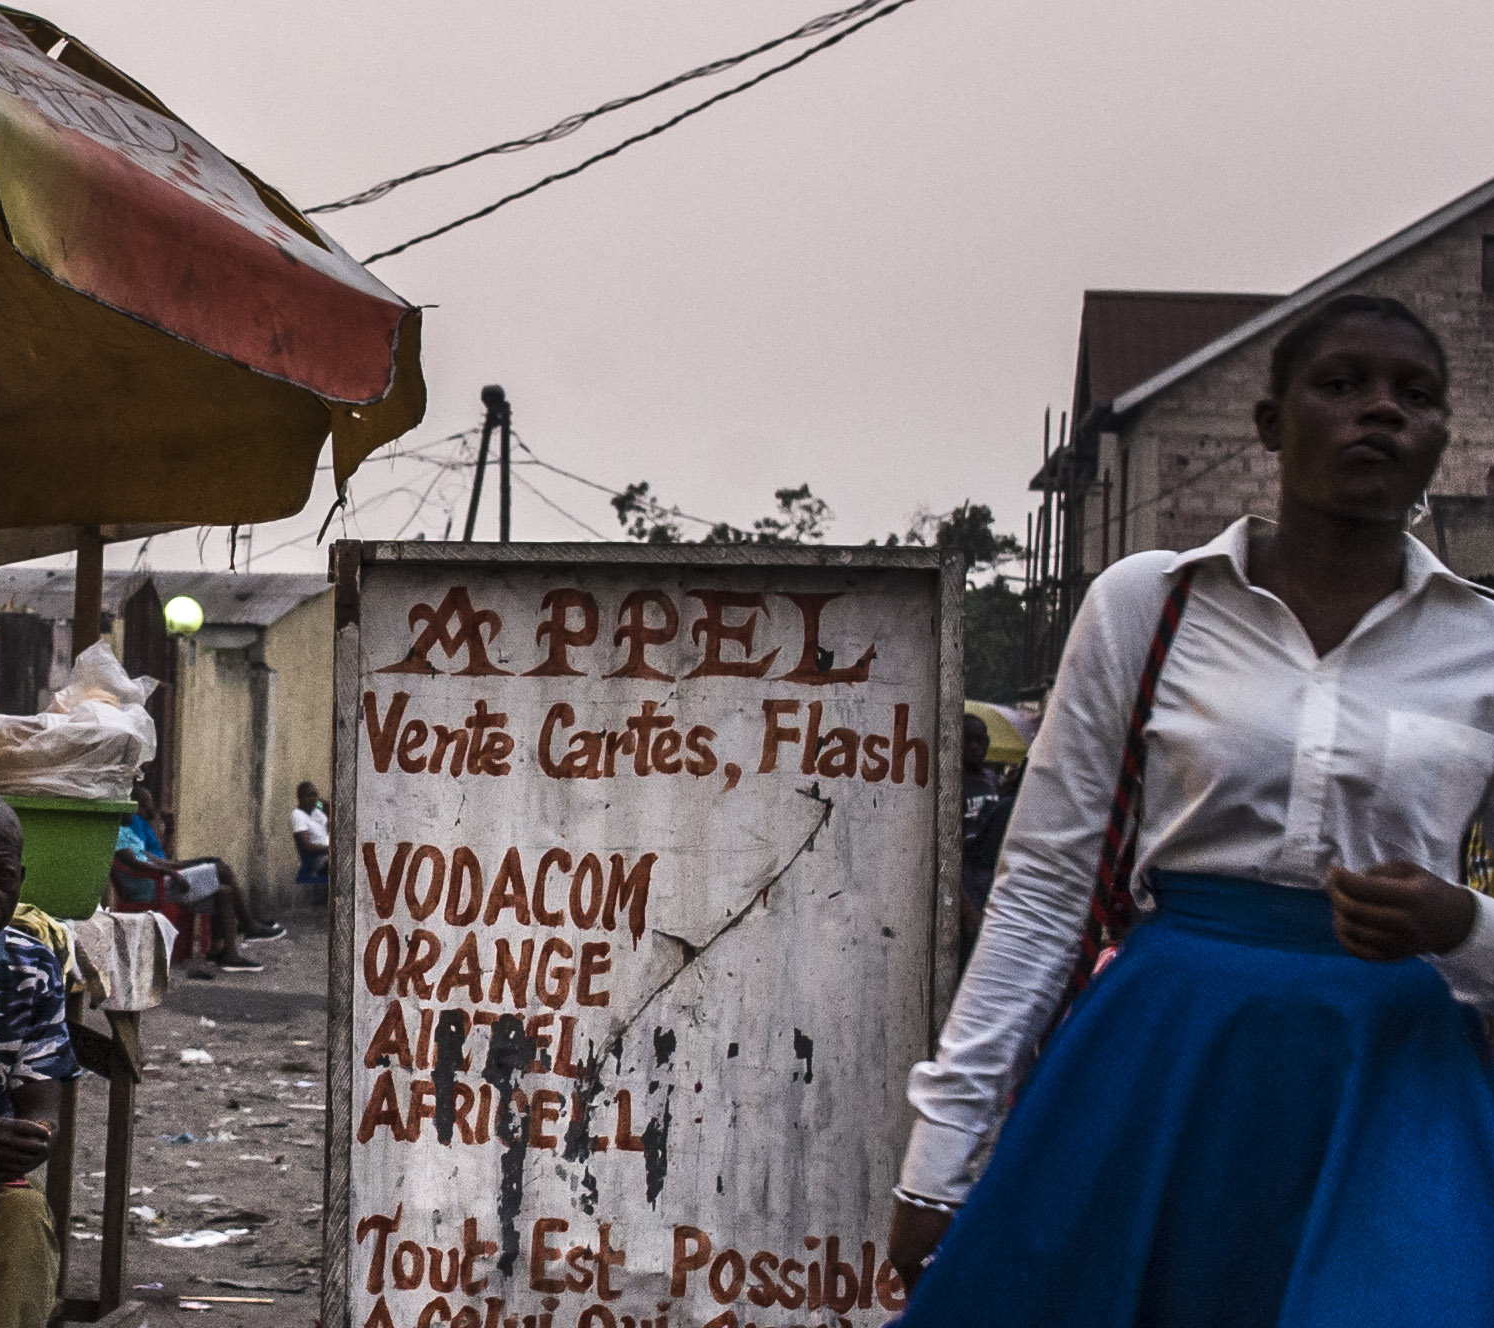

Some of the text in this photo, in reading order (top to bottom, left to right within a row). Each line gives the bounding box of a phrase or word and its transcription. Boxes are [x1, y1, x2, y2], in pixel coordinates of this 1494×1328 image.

[373, 585, 878, 684] APPEL
[362, 690, 930, 793] Vente Cartes, Flash
[363, 843, 657, 949] VODACOM
[362, 926, 613, 1009] ORANGE
[356, 1202, 907, 1315] Tout Est Possible
